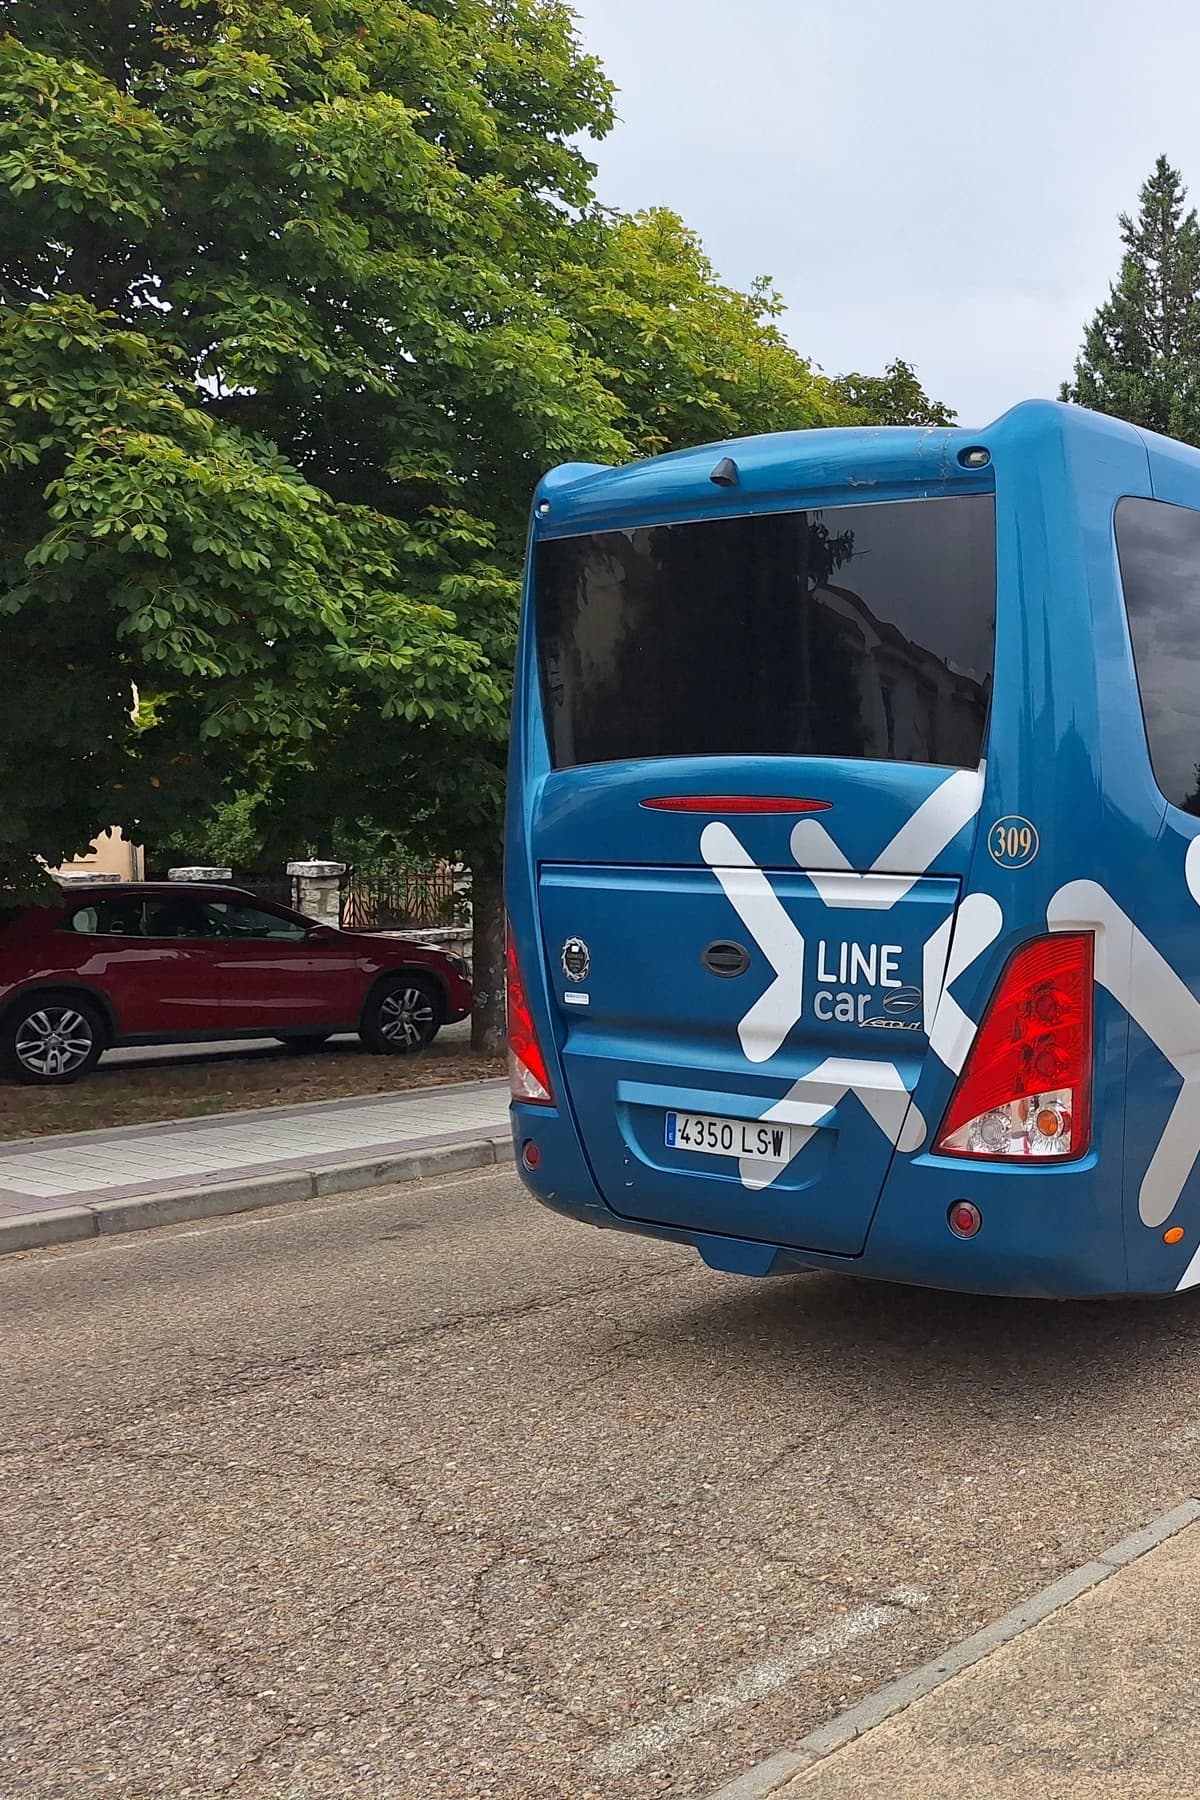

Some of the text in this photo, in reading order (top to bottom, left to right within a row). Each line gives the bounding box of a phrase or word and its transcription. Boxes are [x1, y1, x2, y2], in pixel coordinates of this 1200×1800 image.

[994, 826, 1032, 857] 309
[817, 940, 903, 988] LINE
[814, 991, 872, 1022] car
[680, 1118, 784, 1157] 4350 LSW
